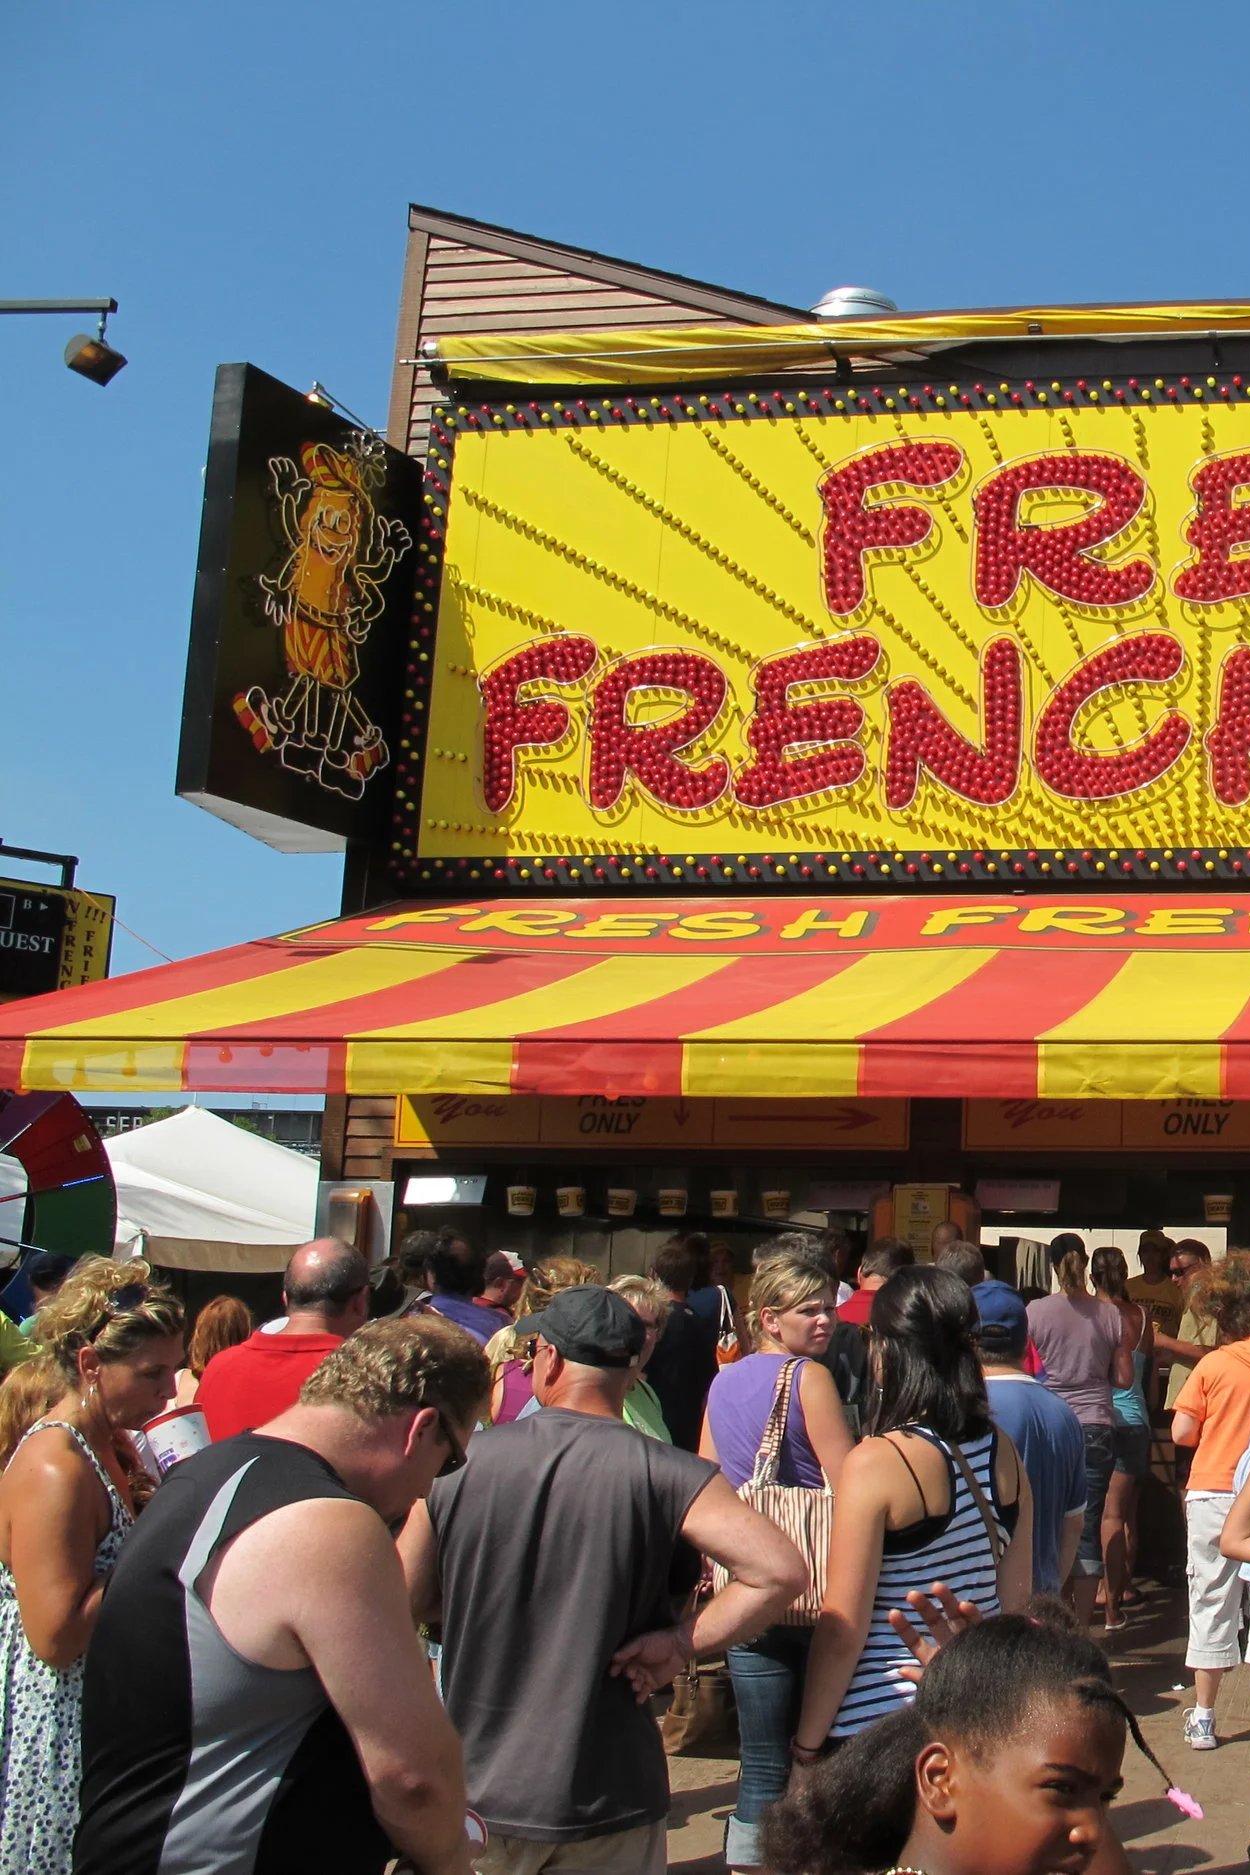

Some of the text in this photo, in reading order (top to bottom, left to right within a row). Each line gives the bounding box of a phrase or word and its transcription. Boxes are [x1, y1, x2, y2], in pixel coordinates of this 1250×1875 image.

[363, 906, 872, 940] FRESH
[579, 1112, 641, 1134] ONLY
[1163, 1112, 1230, 1135] ONLY
